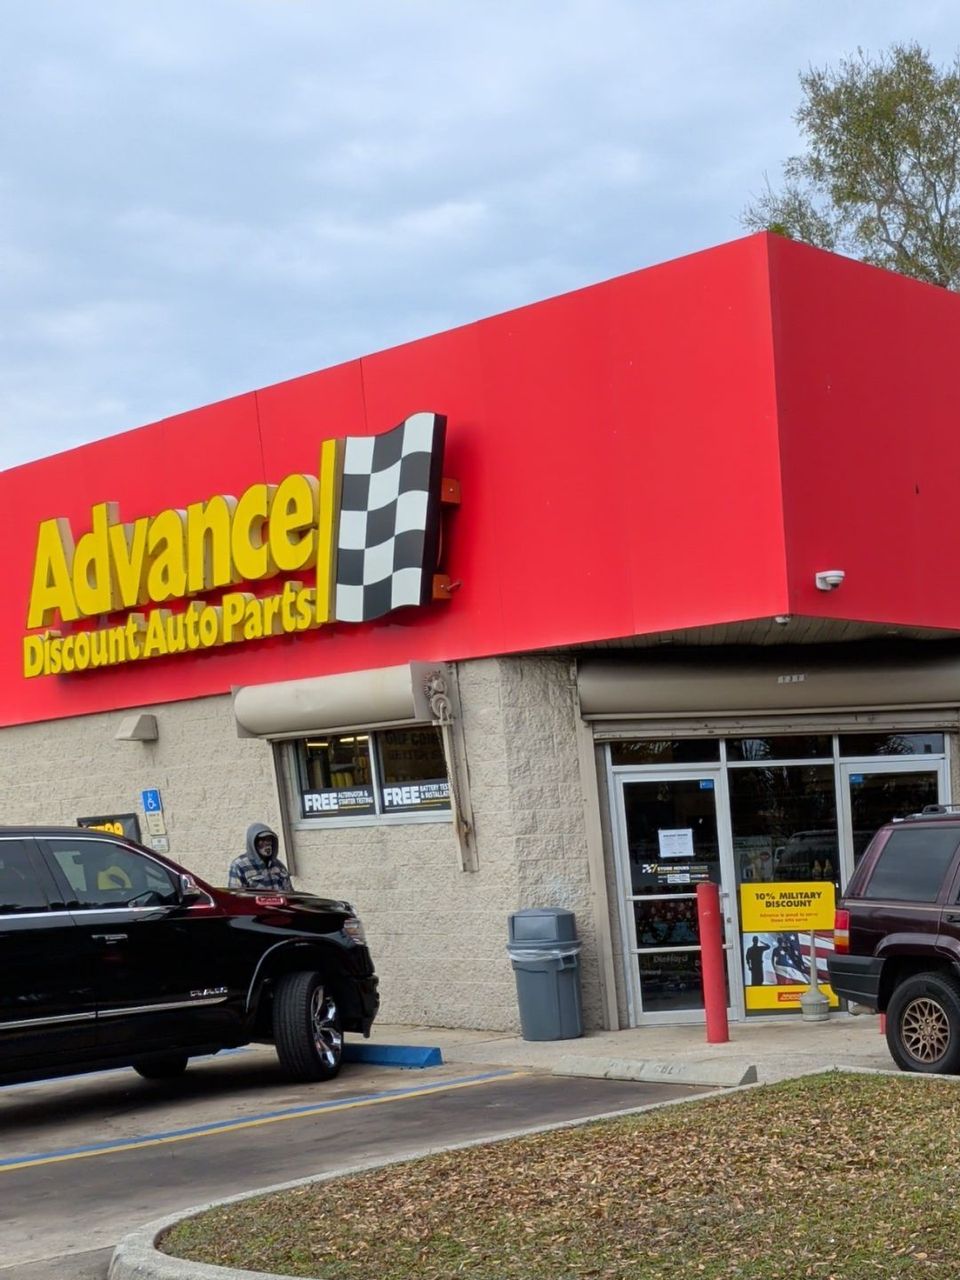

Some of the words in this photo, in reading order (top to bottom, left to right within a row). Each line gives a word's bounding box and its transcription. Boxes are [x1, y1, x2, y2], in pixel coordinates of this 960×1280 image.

[27, 474, 320, 628] Advance
[23, 615, 143, 678] Discount
[143, 602, 218, 657] Auto
[222, 583, 314, 644] Parts
[304, 792, 339, 812] FREE
[383, 786, 421, 806] FREE
[755, 892, 776, 901] 10%
[779, 891, 822, 900] MILITARY
[765, 900, 812, 908] DISCOUNT
